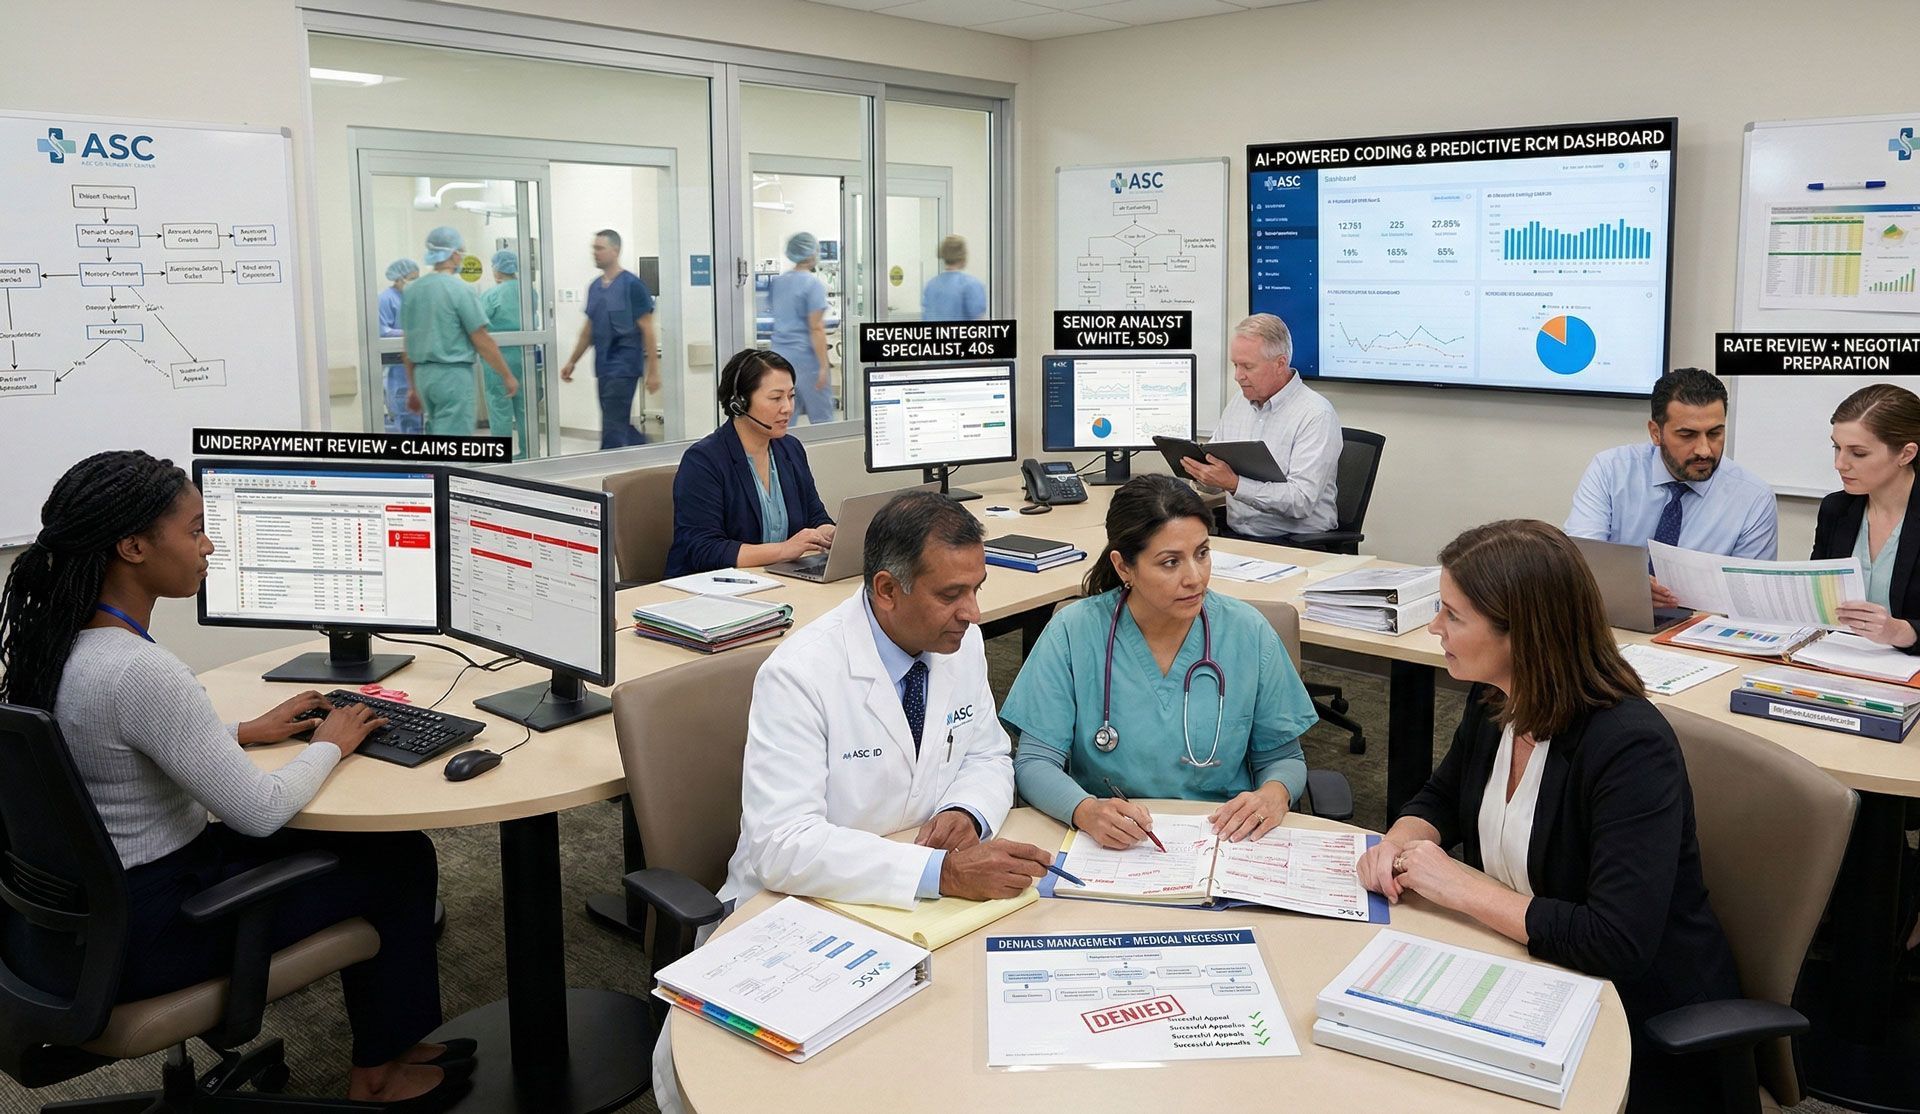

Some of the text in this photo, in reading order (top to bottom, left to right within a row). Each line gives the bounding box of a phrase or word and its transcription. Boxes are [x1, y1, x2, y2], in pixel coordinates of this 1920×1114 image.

[81, 133, 155, 161] ASC
[1129, 172, 1164, 189] ASC
[1277, 175, 1301, 188] ASC
[1389, 221, 1404, 229] 225
[1431, 220, 1461, 229] 27.85%
[953, 705, 974, 723] ASC
[852, 749, 870, 758] ASC
[873, 748, 882, 757] ID
[998, 939, 1044, 949] DENIALS
[1046, 937, 1123, 948] MANAGEMENT
[1133, 935, 1182, 946] MEDICAL
[1183, 932, 1241, 946] NECESSITY
[852, 968, 882, 989] ASC
[1092, 1001, 1174, 1028] DENIED
[1204, 1014, 1229, 1022] Appeal
